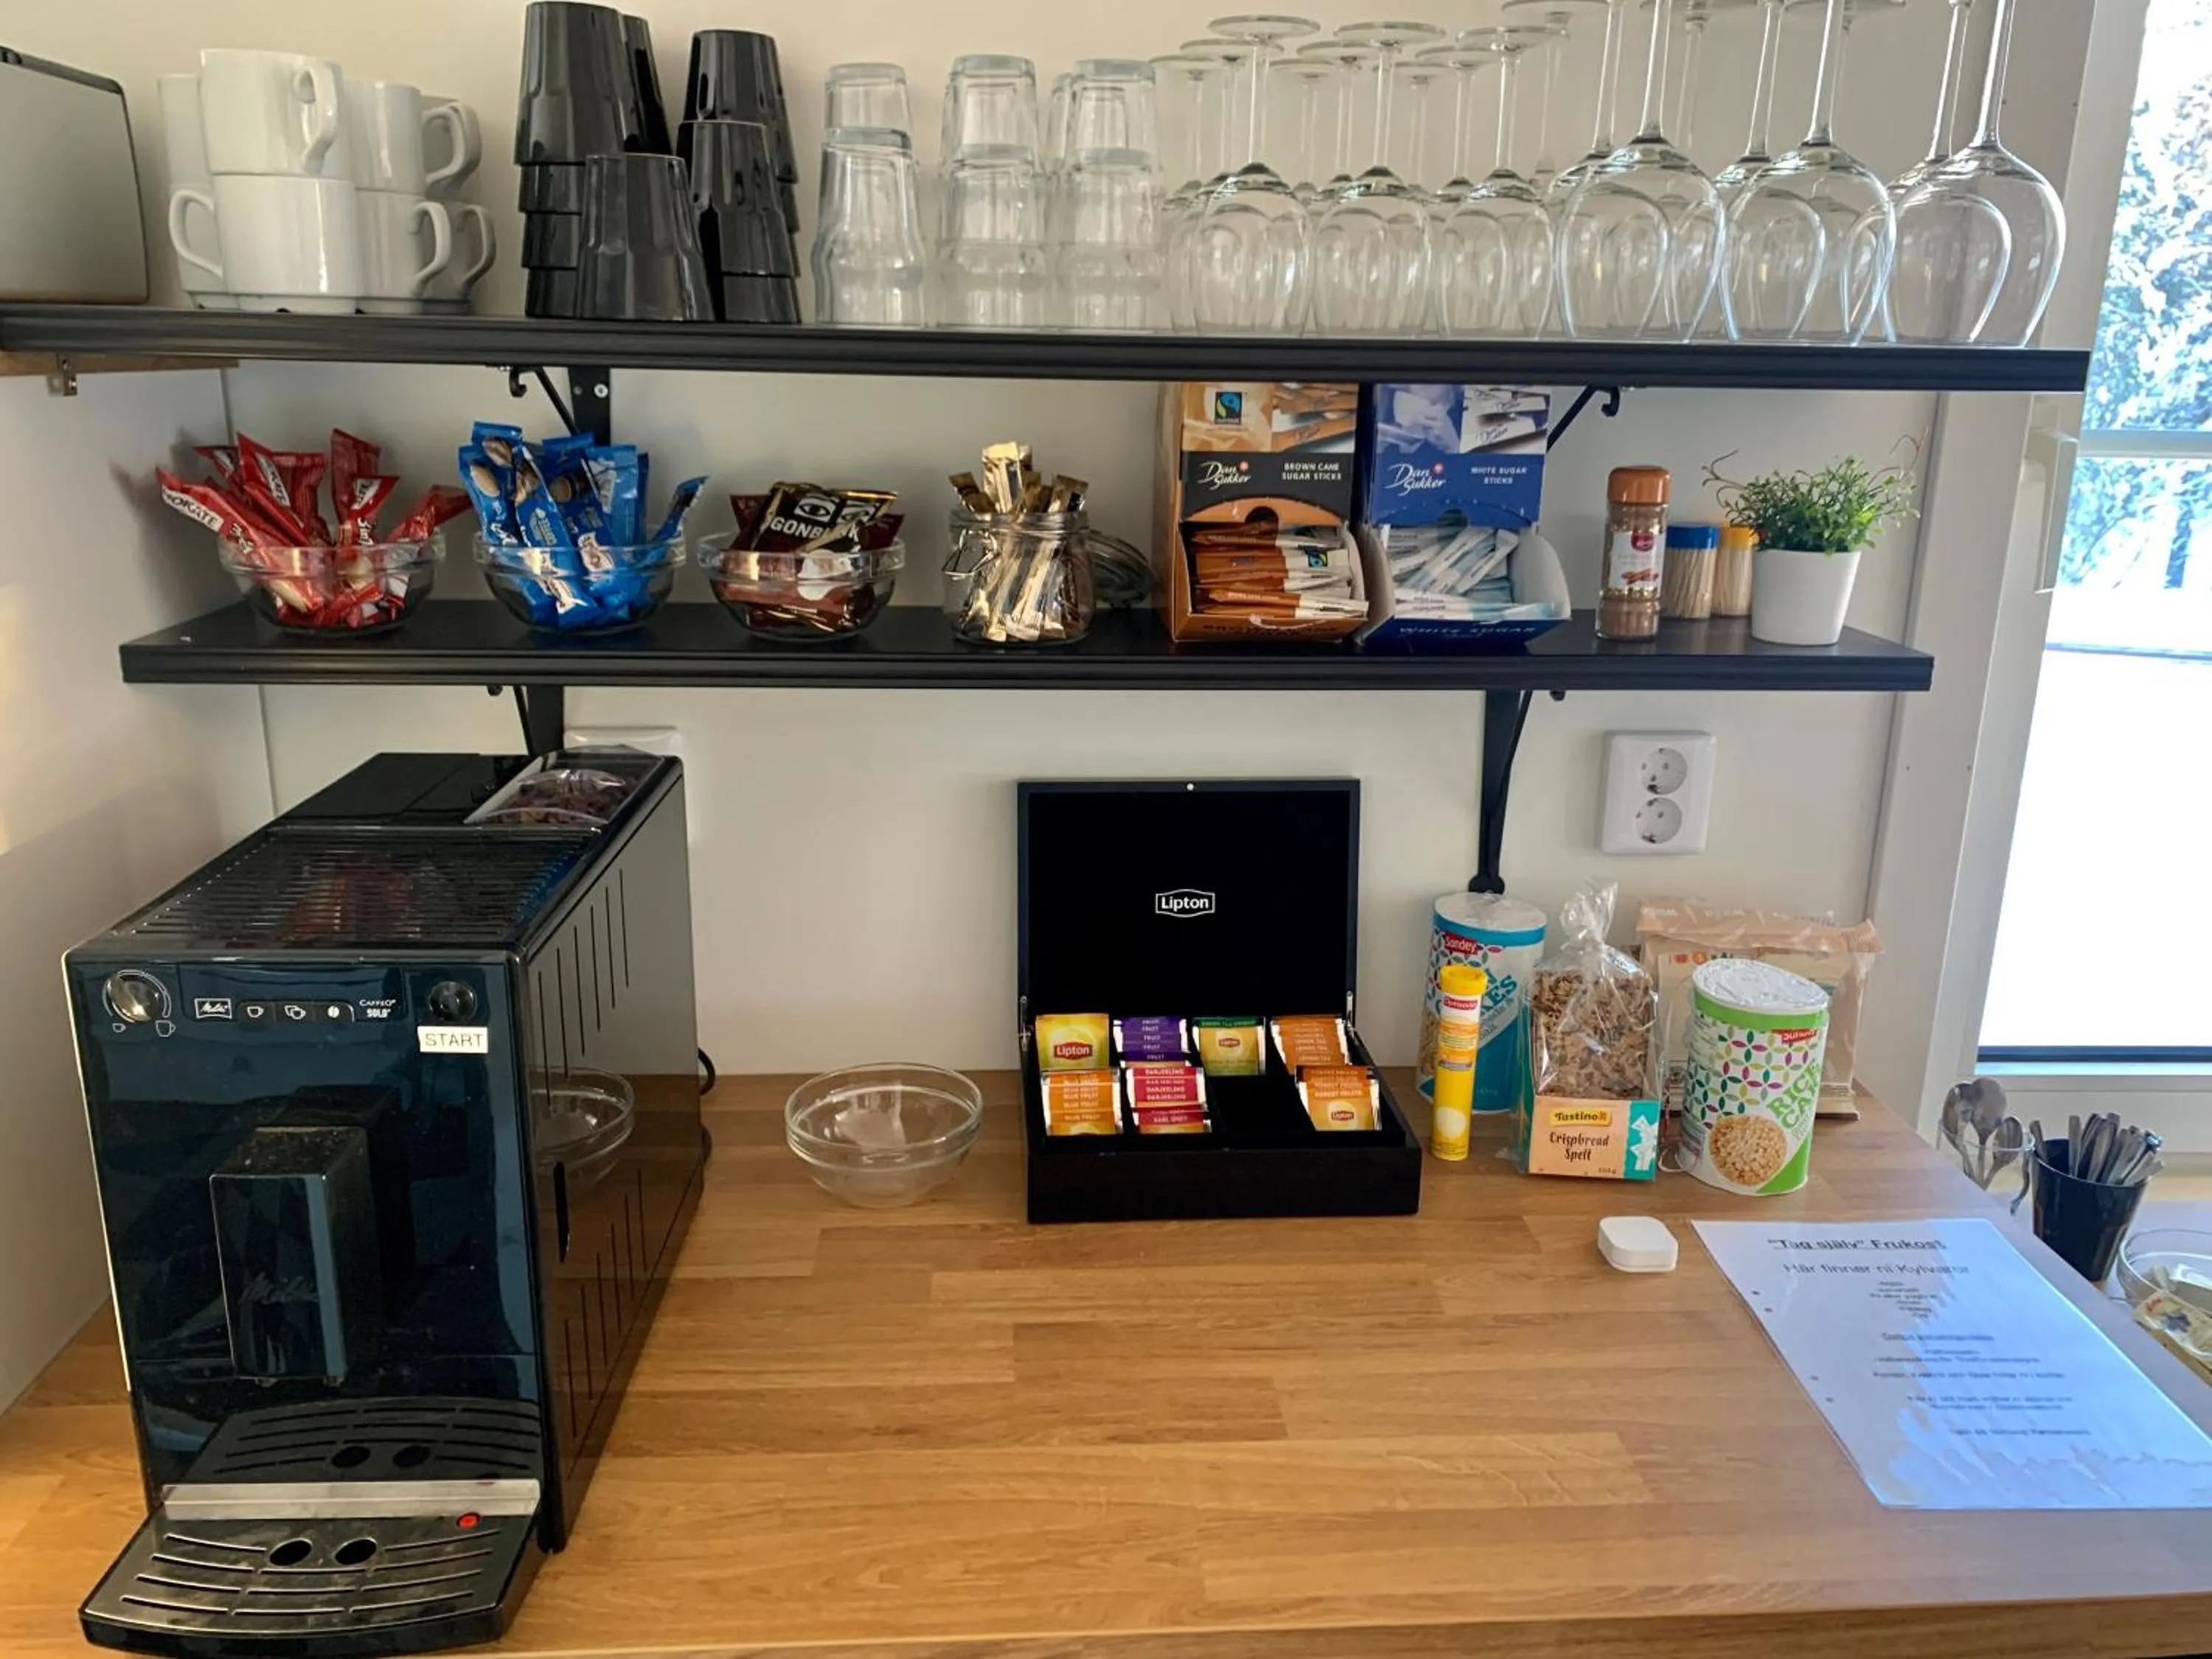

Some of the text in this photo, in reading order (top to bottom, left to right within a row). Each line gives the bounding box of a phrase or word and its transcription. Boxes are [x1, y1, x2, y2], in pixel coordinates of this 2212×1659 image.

[1197, 461, 1237, 484] Dan
[1284, 462, 1315, 470] BROWN
[1282, 472, 1341, 480] SUGAR STICKS
[1384, 463, 1430, 488] Dan
[1399, 477, 1446, 495] Sukker
[1161, 896, 1209, 912] Lipton
[425, 1033, 484, 1047] START
[1057, 1046, 1090, 1058] Lipton
[1554, 1112, 1598, 1121] Tastino
[1549, 1132, 1610, 1147] Crispbread
[1565, 1148, 1592, 1162] Spelt
[1871, 1239, 1947, 1250] Frukost
